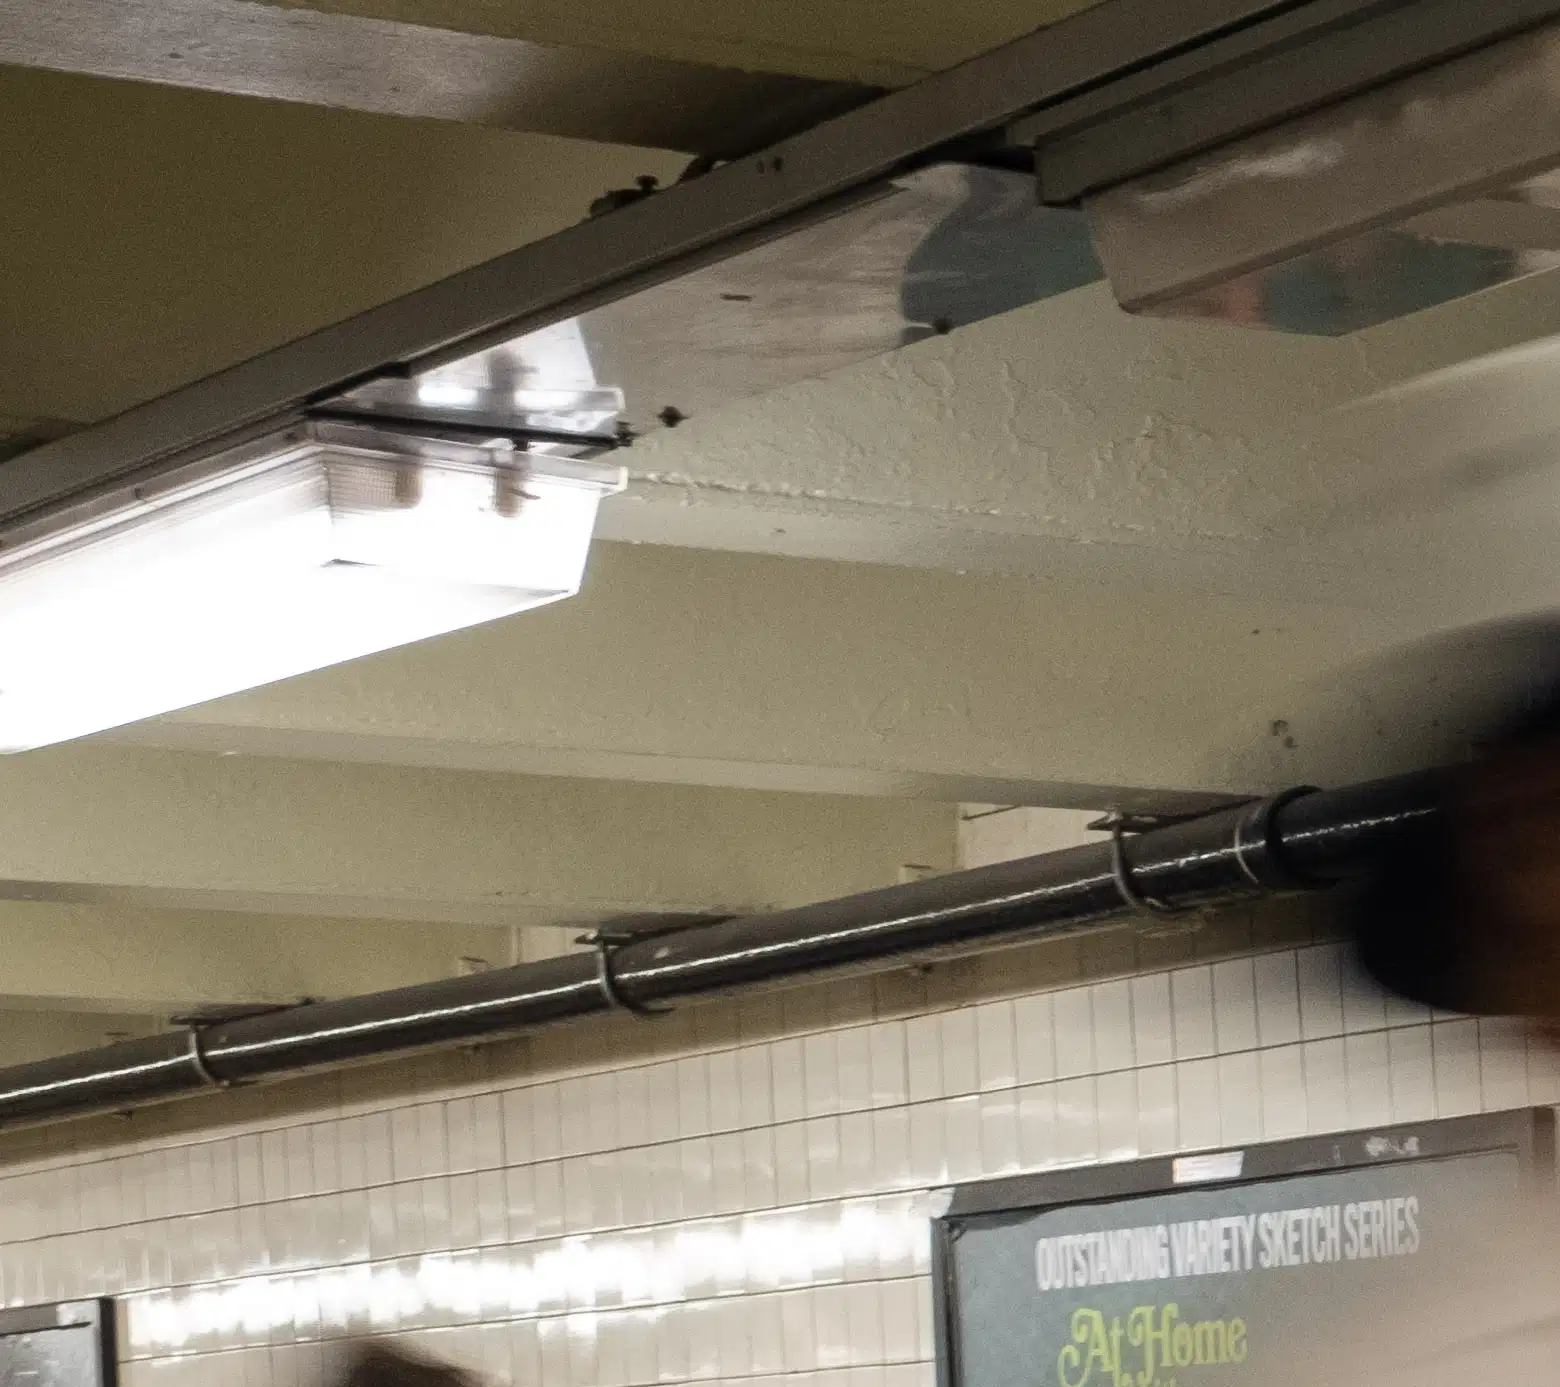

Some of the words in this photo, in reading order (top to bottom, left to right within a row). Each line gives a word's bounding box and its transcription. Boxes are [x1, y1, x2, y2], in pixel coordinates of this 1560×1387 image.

[1035, 1225, 1171, 1291] OUTSTANDING
[1170, 1213, 1257, 1279] VARIETY
[1257, 1204, 1341, 1270] SKETCH
[1343, 1195, 1420, 1261] SERIES
[1127, 1303, 1247, 1387] Home
